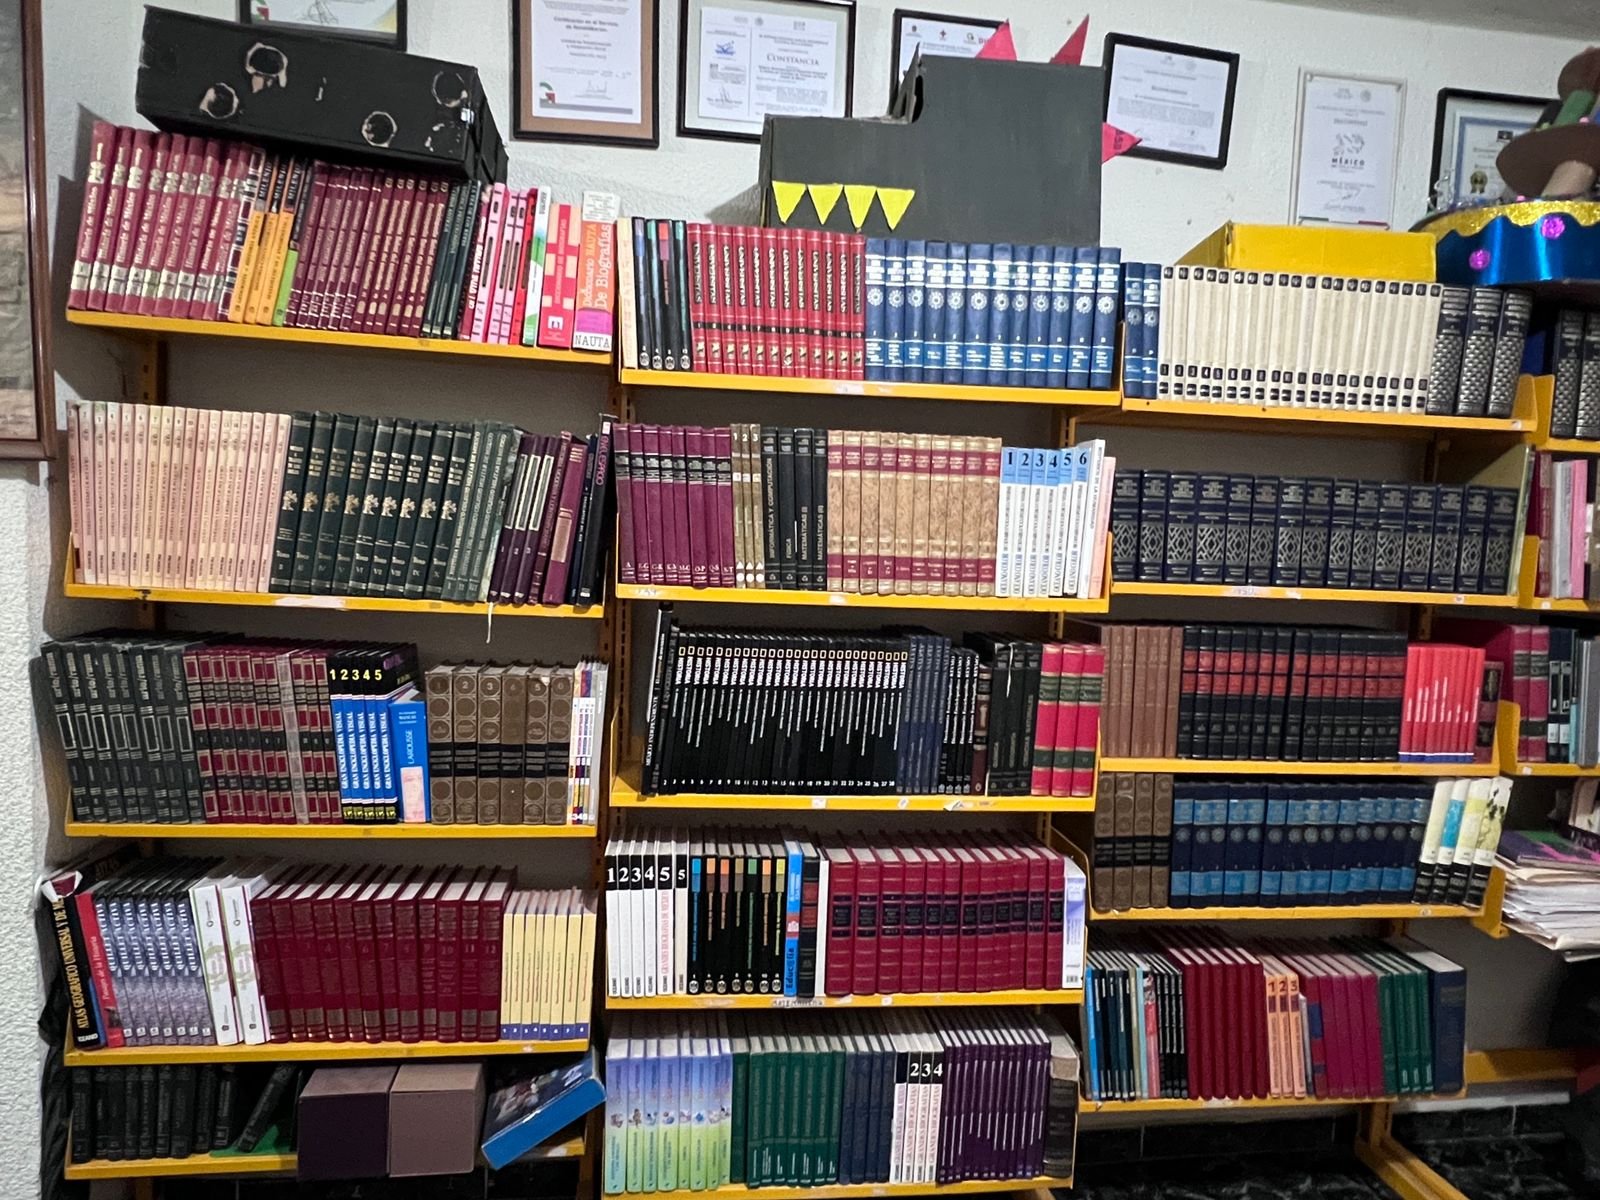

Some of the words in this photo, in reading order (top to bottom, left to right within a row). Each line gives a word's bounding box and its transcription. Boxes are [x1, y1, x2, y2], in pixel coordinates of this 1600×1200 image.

[585, 224, 596, 256] NAUTA
[595, 224, 612, 288] Biografías
[594, 292, 607, 308] De
[575, 335, 610, 349] NAUTA
[734, 433, 738, 441] 1
[742, 433, 747, 441] 2
[753, 433, 758, 441] 3
[1007, 452, 1013, 466] 1
[1021, 453, 1029, 466] 2
[1035, 453, 1044, 467] 3
[1049, 454, 1058, 468] 4
[1063, 452, 1072, 466] 5
[1079, 452, 1087, 465] 6
[330, 669, 336, 680] 1
[341, 669, 349, 680] 2
[352, 669, 360, 680] 3
[363, 669, 370, 680] 4
[375, 669, 382, 680] 5
[675, 658, 684, 684] HISTORIA
[694, 658, 702, 684] HISTORIA
[713, 658, 721, 684] HISTORIA
[730, 658, 739, 685] HISTORIA
[748, 659, 756, 685] HISTORIA
[766, 659, 774, 686] HISTORIA
[800, 660, 808, 687] HISTORIA
[834, 661, 842, 687] HISTORIA
[462, 681, 468, 689] 2
[487, 682, 493, 691] 3
[535, 683, 541, 692] 5
[337, 734, 346, 772] ENCICLOPEDIA
[348, 734, 357, 772] ENCICLOPEDIA
[359, 734, 368, 772] ENCICLOPEDIA
[370, 734, 379, 772] ENCICLOPEDIA
[381, 734, 390, 772] ENCICLOPEDIA
[405, 730, 414, 764] LAROUSSE
[607, 868, 615, 882] 1
[619, 867, 629, 882] 2
[631, 867, 642, 882] 3
[644, 866, 654, 880] 4
[659, 866, 670, 881] 5
[678, 869, 686, 880] 5
[53, 909, 66, 920] DE
[58, 927, 77, 964] UNIVERSAL
[1268, 981, 1275, 992] 1
[1279, 981, 1286, 992] 2
[1290, 980, 1297, 992] 3
[75, 1008, 89, 1028] ATLAS
[910, 1063, 919, 1077] 2
[922, 1063, 931, 1077] 3
[933, 1063, 943, 1077] 4
